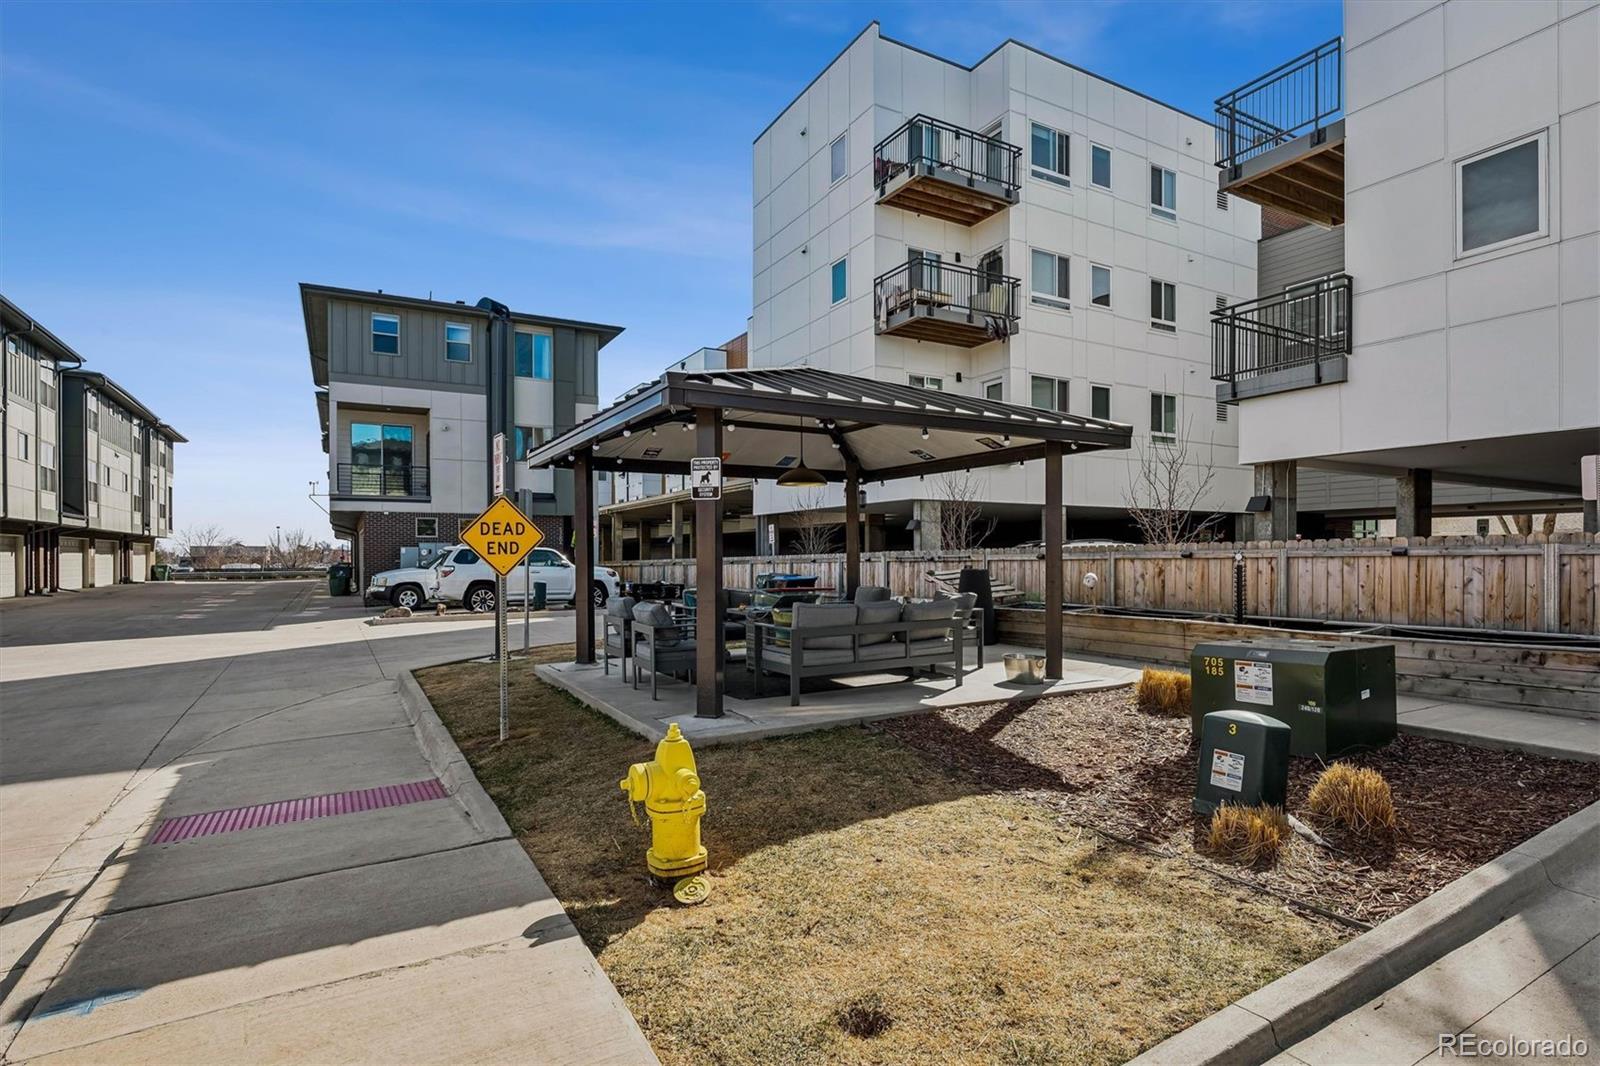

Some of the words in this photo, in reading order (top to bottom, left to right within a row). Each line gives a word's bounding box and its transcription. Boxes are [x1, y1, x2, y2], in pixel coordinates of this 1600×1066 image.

[480, 522, 525, 536] DEAD
[487, 541, 520, 555] END
[1204, 657, 1224, 667] 705
[1205, 666, 1224, 676] 185
[1228, 723, 1237, 735] 3
